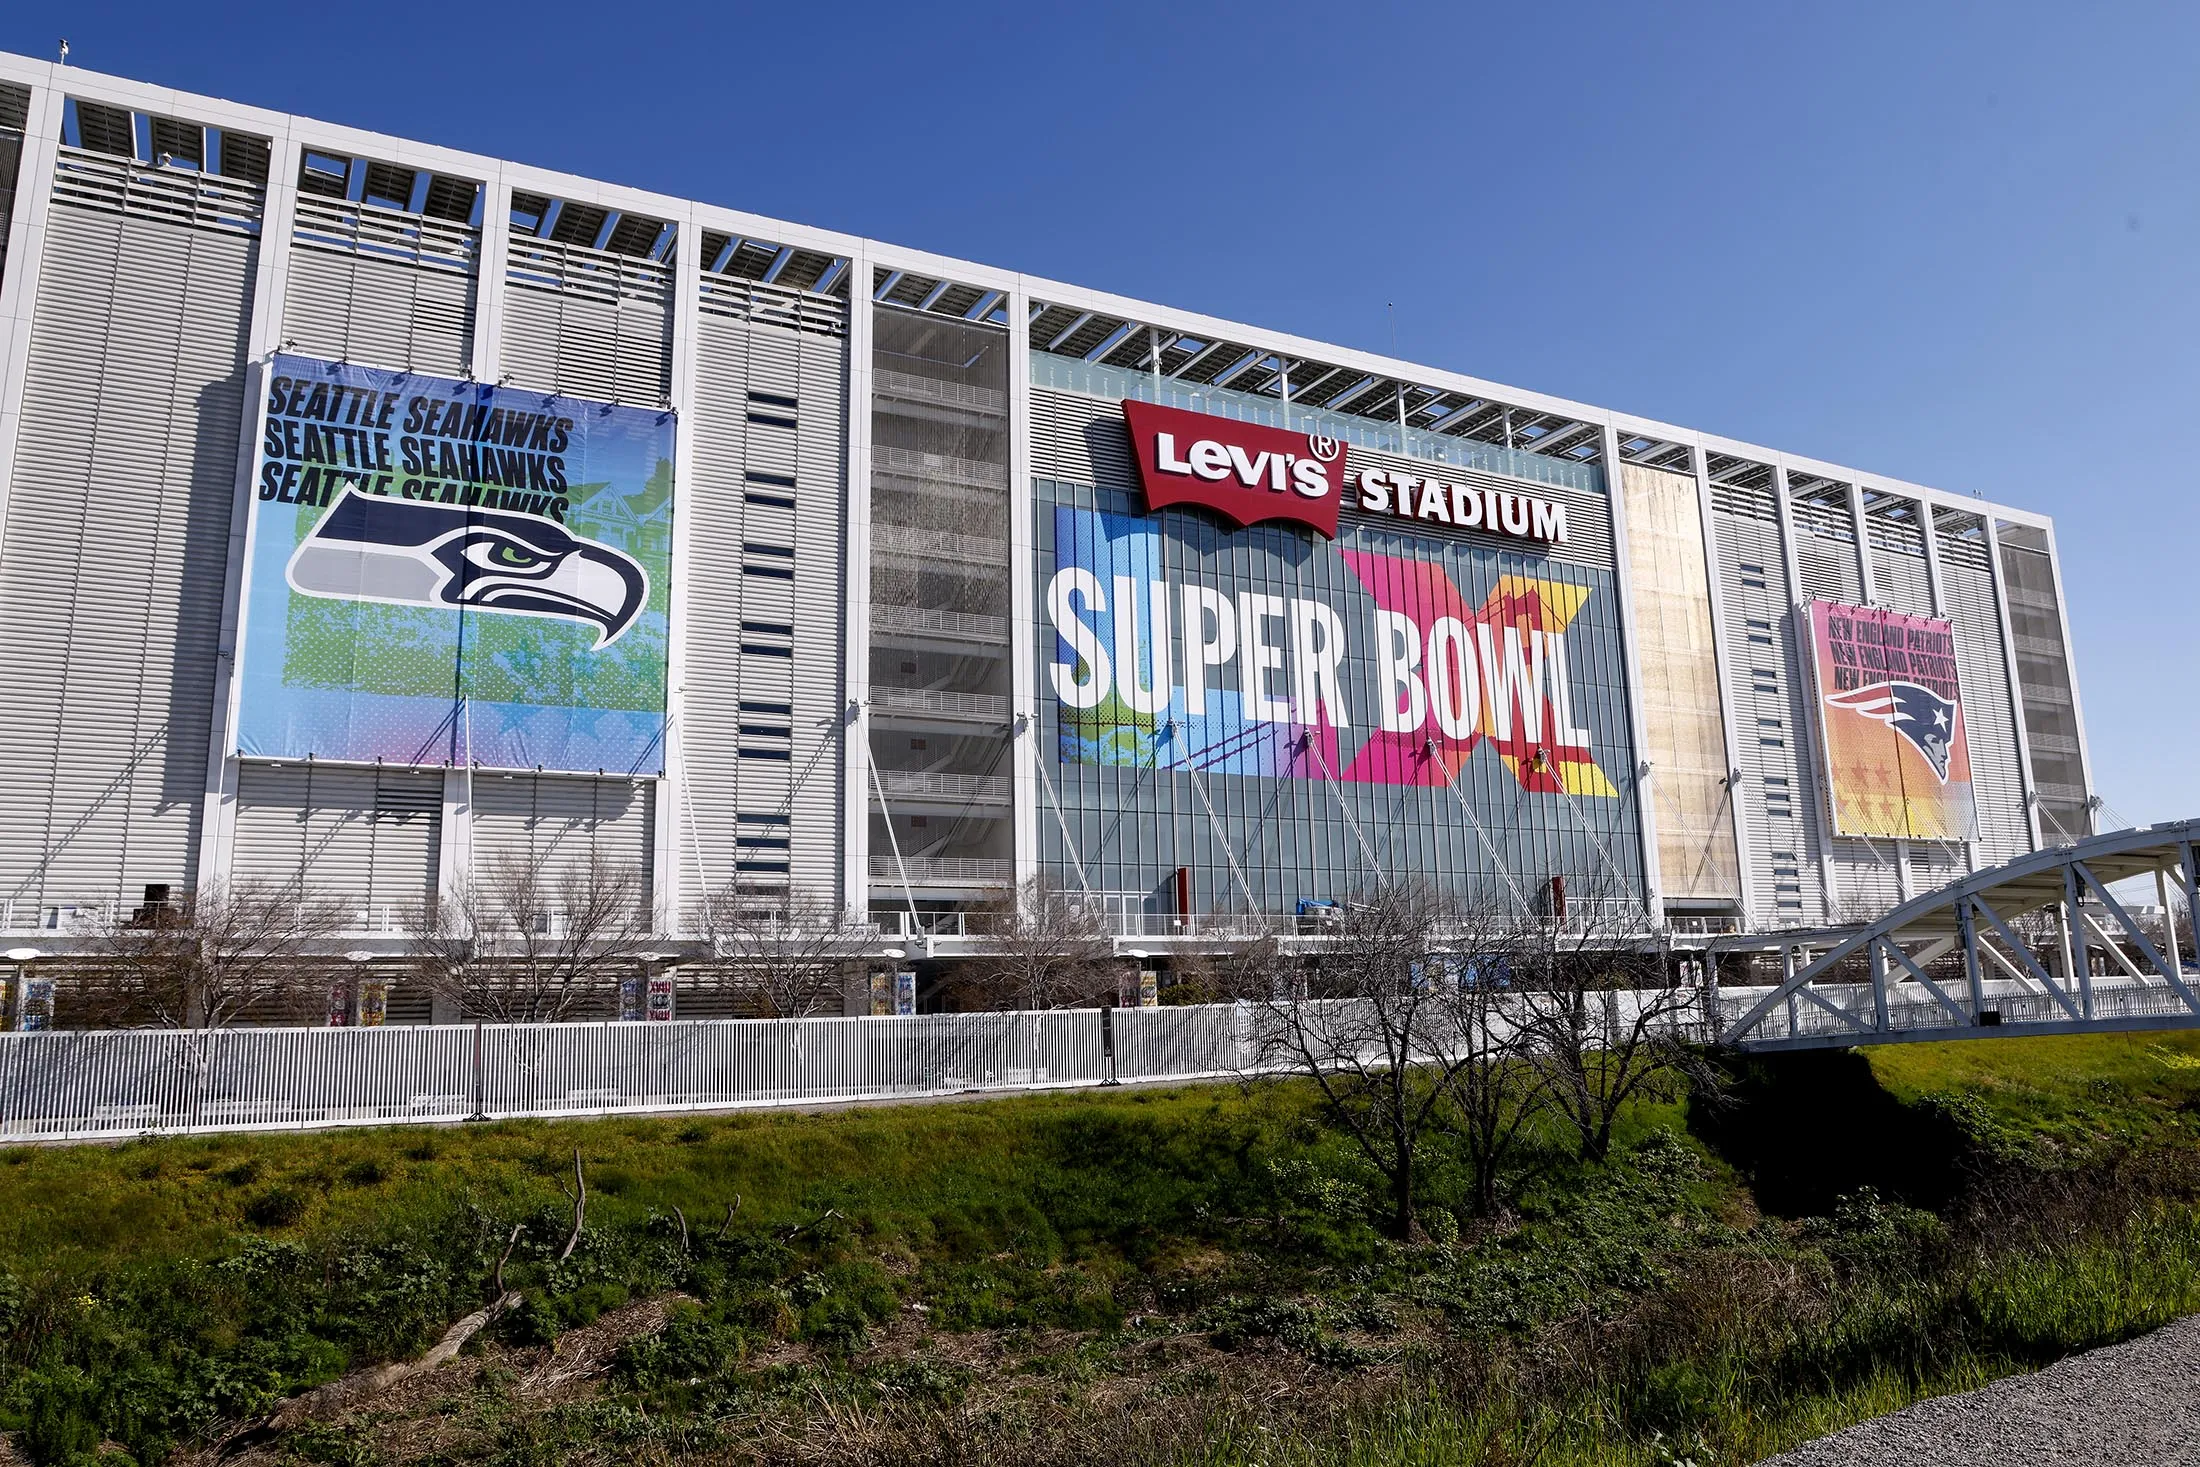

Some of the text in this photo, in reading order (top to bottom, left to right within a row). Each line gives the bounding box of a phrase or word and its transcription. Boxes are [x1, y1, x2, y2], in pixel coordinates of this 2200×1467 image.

[267, 376, 574, 453] SEATTLE SEAHAWKS
[264, 417, 568, 494] SEATTLE SEAHAWKS
[1358, 468, 1568, 544] STADIUM
[1047, 567, 1590, 749] SUPER BOWL
[1828, 615, 1956, 657] NEW ENGLAND PATRIOTS
[1829, 641, 1858, 667] NEW
[1857, 645, 1909, 673] ENGLAND
[1908, 652, 1959, 681] PATRIOTS
[1834, 666, 1860, 691] NEW
[1913, 677, 1961, 701] RIOTS
